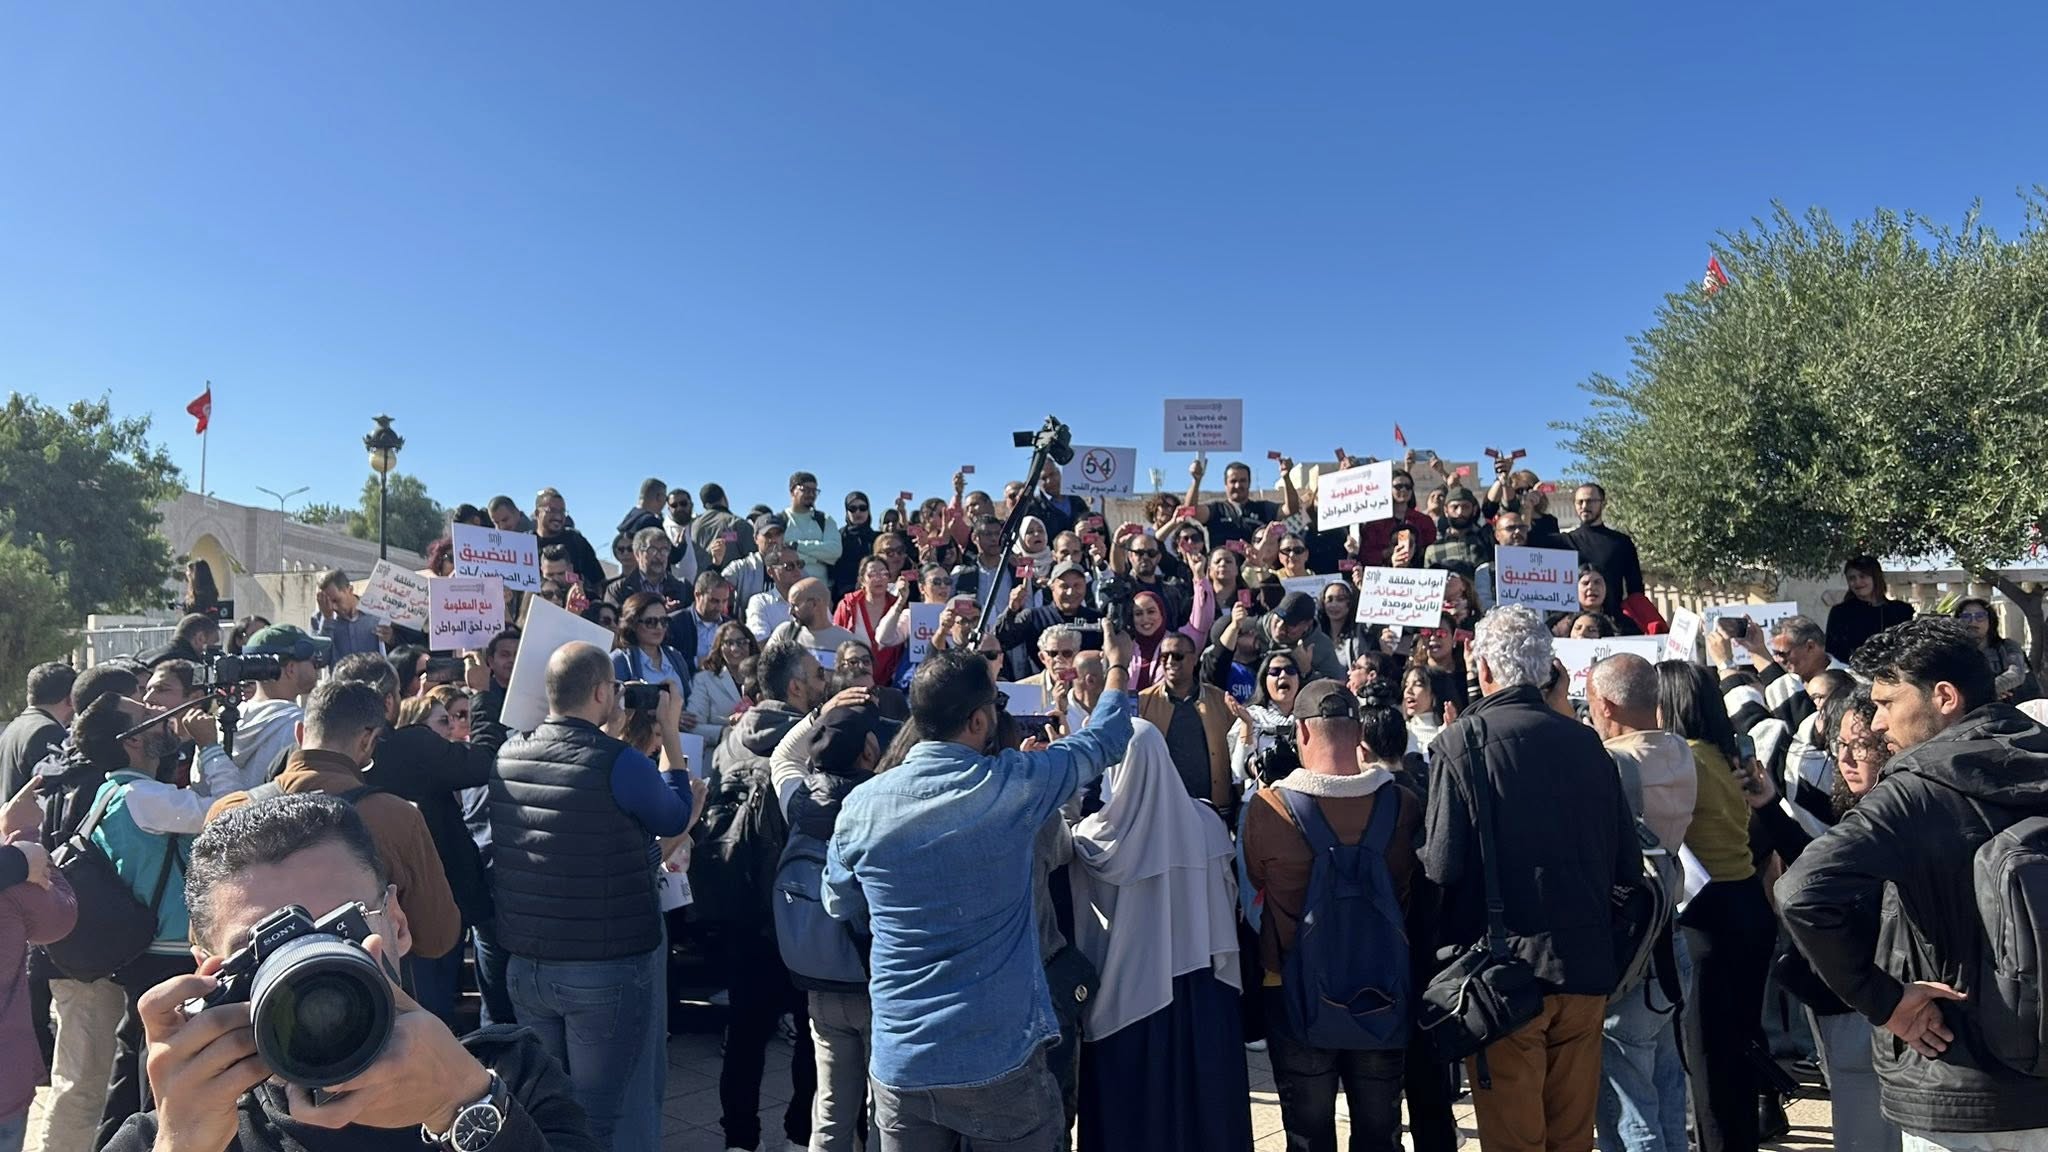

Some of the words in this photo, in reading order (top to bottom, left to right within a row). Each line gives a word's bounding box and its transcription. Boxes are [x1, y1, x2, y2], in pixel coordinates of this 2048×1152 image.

[1085, 457, 1111, 474] 54
[1331, 484, 1363, 499] المعلومة
[1364, 482, 1379, 495] منع
[1353, 500, 1368, 514] لحق
[1369, 496, 1389, 509] ضرب
[1322, 503, 1352, 519] المواطن
[459, 543, 517, 564] للتضييق
[523, 552, 534, 566] لا
[523, 574, 537, 586] على
[1418, 576, 1443, 587] أبواب
[1501, 566, 1557, 585] للتضييق
[1563, 569, 1574, 584] لا
[1414, 587, 1440, 603] على
[1561, 593, 1576, 606] على
[444, 598, 477, 614] المعلومة
[479, 599, 492, 614] منع
[1381, 598, 1413, 611] موصدة
[1415, 601, 1439, 612] زنازين
[1395, 609, 1422, 622] على
[435, 620, 466, 635] المواطن
[468, 620, 482, 635] لحق
[484, 619, 502, 634] ضرب
[263, 922, 296, 946] SONY
